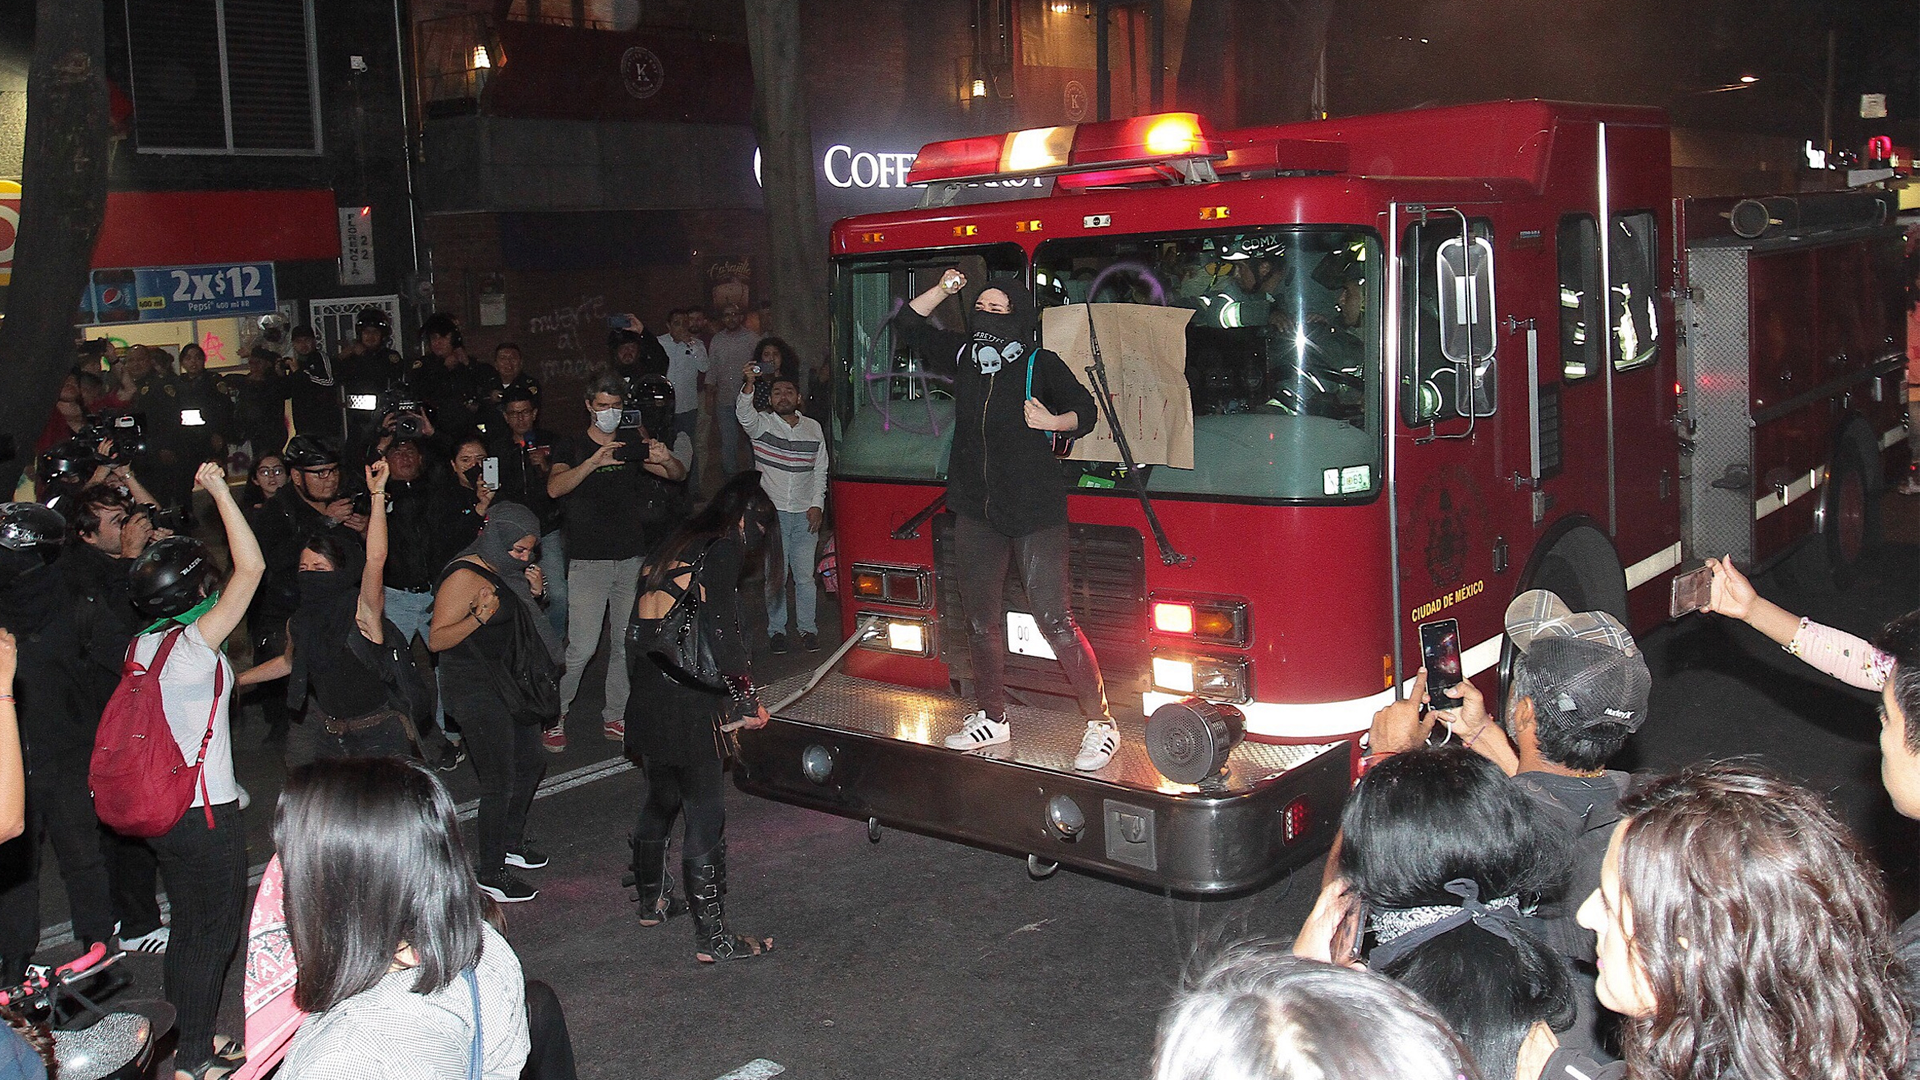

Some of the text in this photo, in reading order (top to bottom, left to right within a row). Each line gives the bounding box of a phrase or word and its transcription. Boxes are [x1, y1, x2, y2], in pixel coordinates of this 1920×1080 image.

[823, 144, 929, 188] COFF
[1241, 234, 1278, 251] CDMX
[1411, 580, 1484, 622] CIUDAD DE MÉXICO
